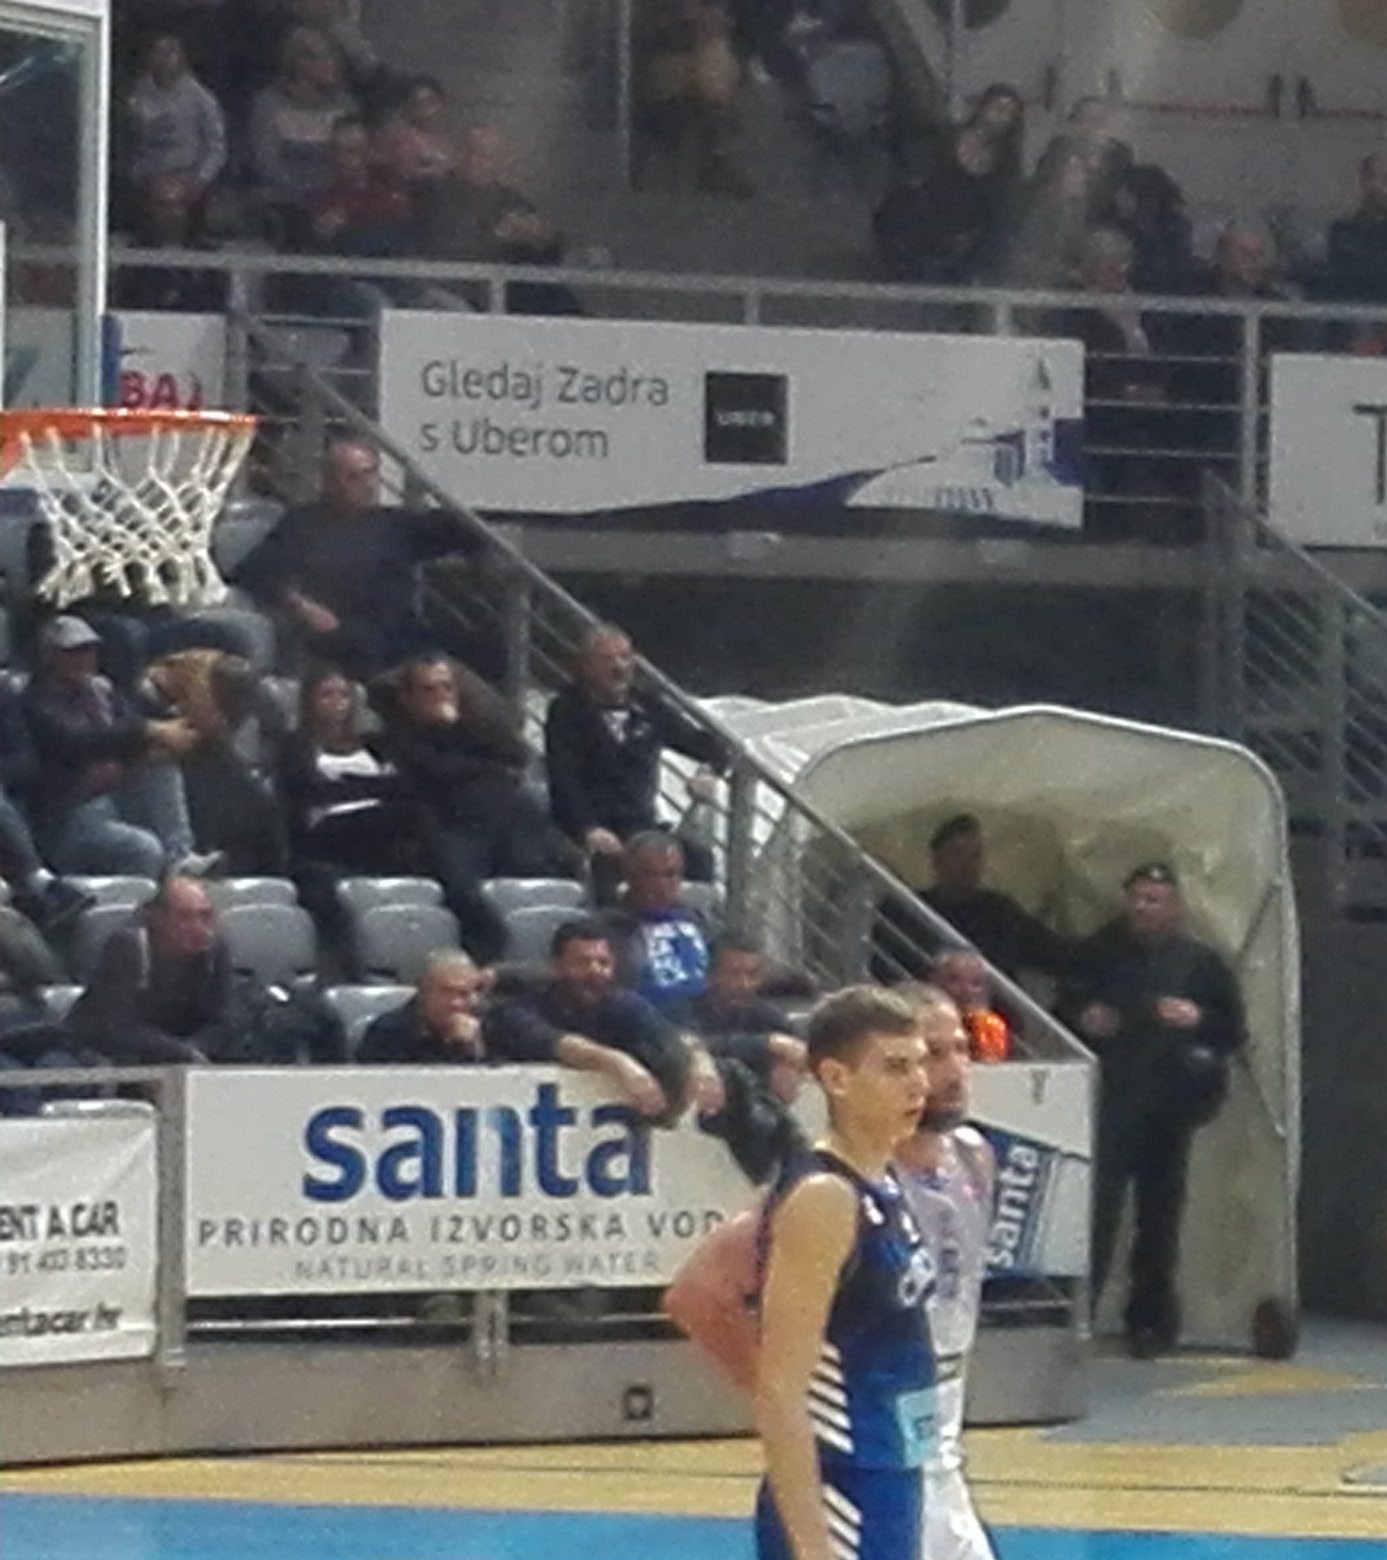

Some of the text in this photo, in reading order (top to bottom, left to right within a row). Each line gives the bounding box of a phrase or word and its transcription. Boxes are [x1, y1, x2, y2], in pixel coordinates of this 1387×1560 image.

[420, 360, 670, 409] Gledaj Zadra
[420, 419, 610, 458] s Uberom
[302, 1082, 652, 1202] santa
[71, 1200, 120, 1237] CAR
[198, 1207, 726, 1248] PRIRODNA IZVORSKA VOD
[986, 1144, 1039, 1270] santa
[295, 1250, 661, 1280] NATURAL SPRING WATER
